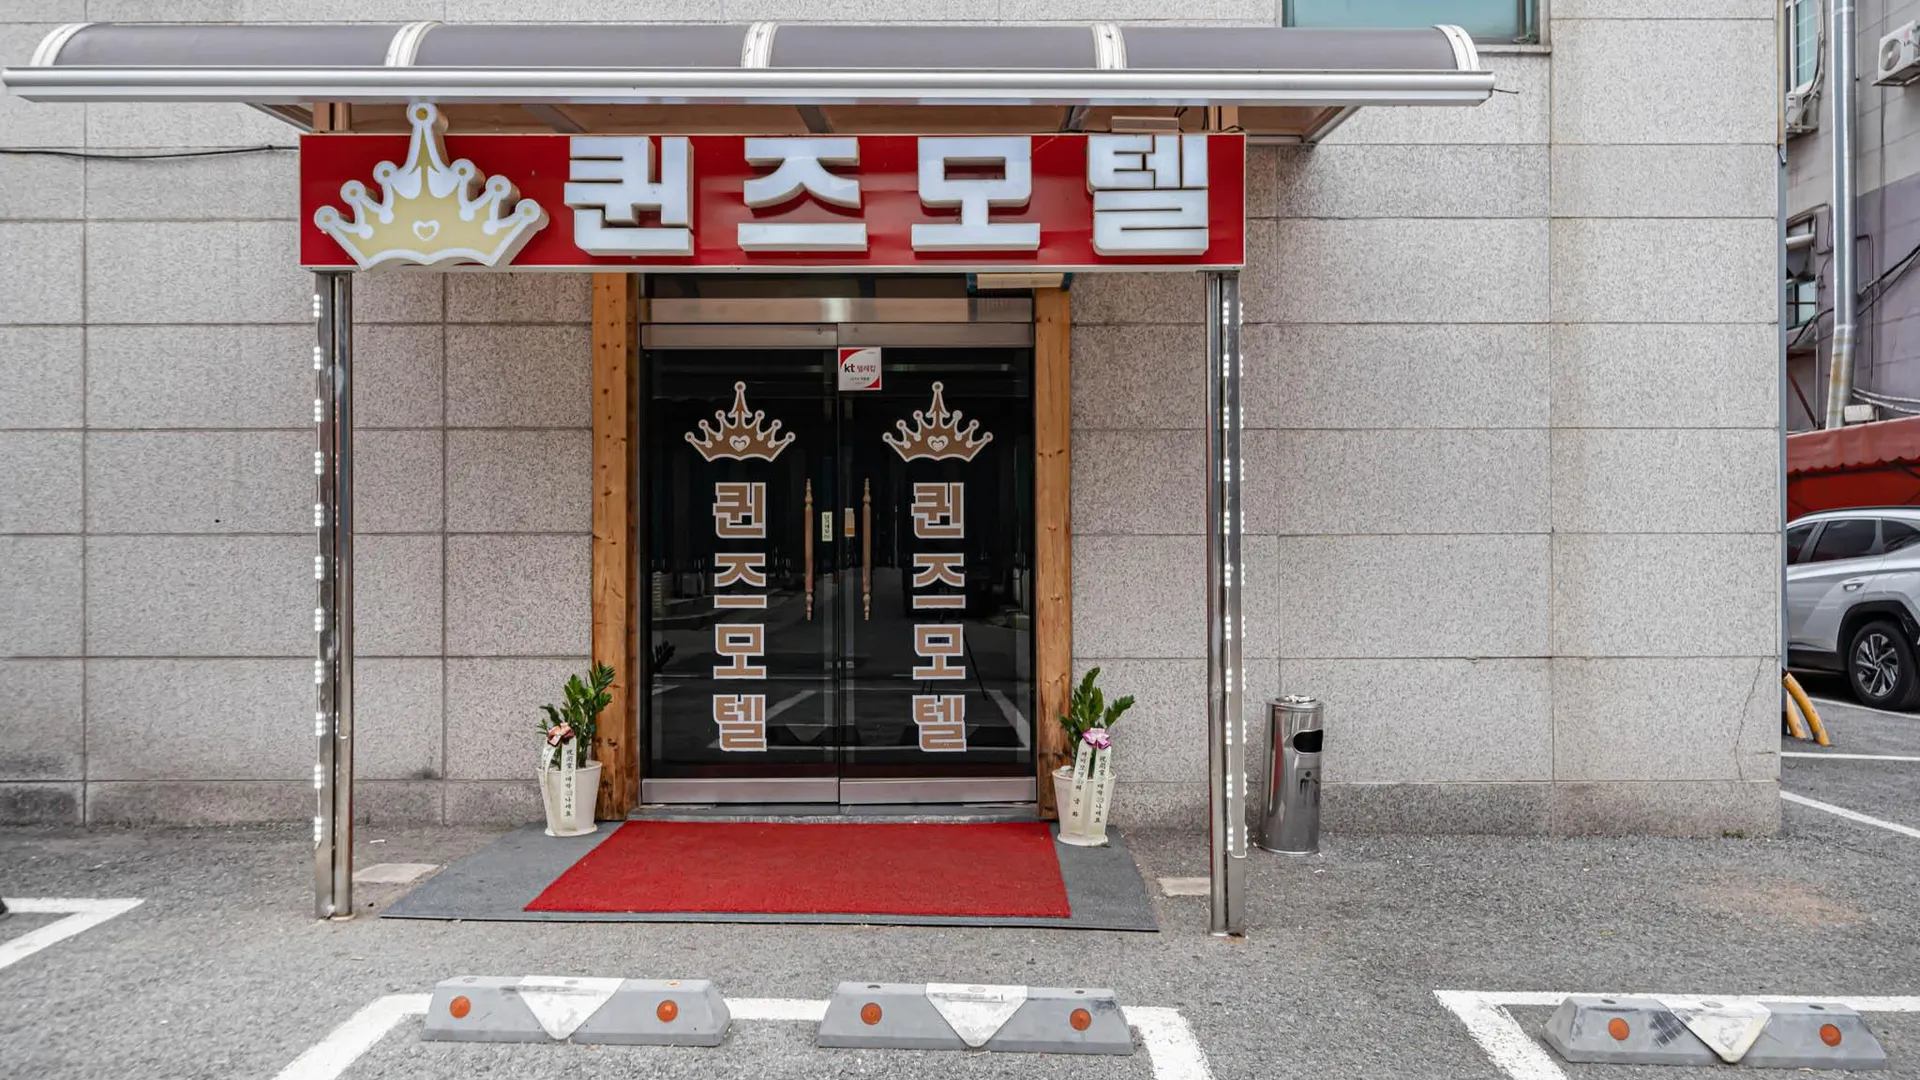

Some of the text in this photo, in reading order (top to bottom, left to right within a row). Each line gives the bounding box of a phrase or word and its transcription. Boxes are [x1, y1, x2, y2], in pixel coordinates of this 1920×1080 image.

[563, 134, 1211, 257] 퀸즈모텔
[844, 364, 855, 373] kt
[712, 481, 768, 753] 퀸즈모텔
[911, 481, 968, 753] 퀸즈모텔
